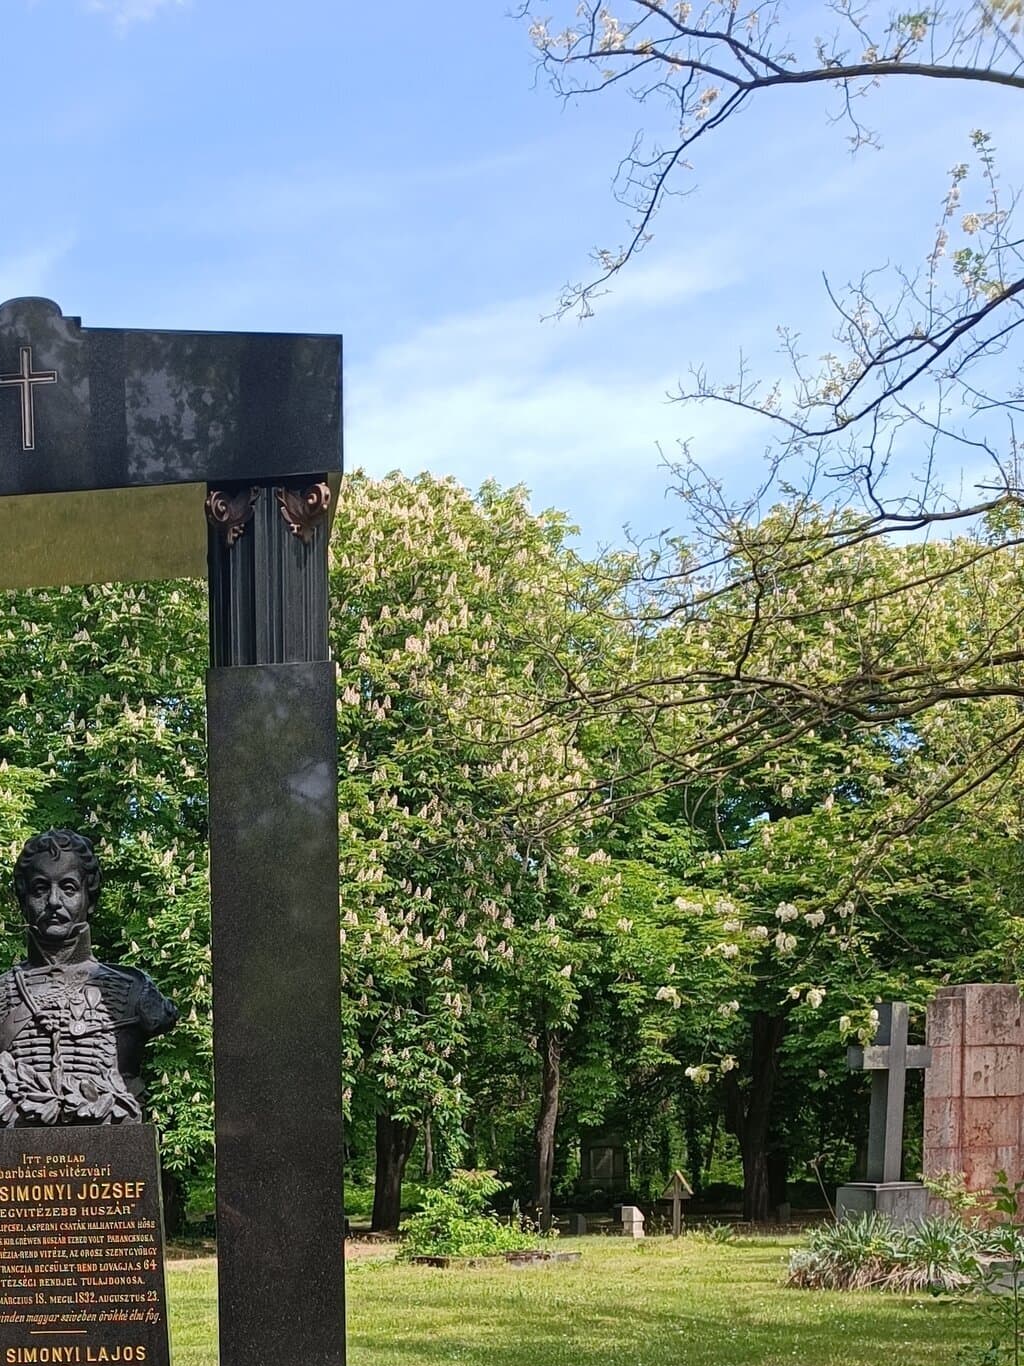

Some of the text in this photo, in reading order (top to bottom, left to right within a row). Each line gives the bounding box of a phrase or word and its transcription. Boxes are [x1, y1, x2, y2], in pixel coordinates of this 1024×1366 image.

[0, 1183, 72, 1202] SIMONYI
[77, 1177, 145, 1200] JÓZSEF
[6, 1346, 81, 1363] SIMONYI
[86, 1345, 146, 1362] LAJOS
